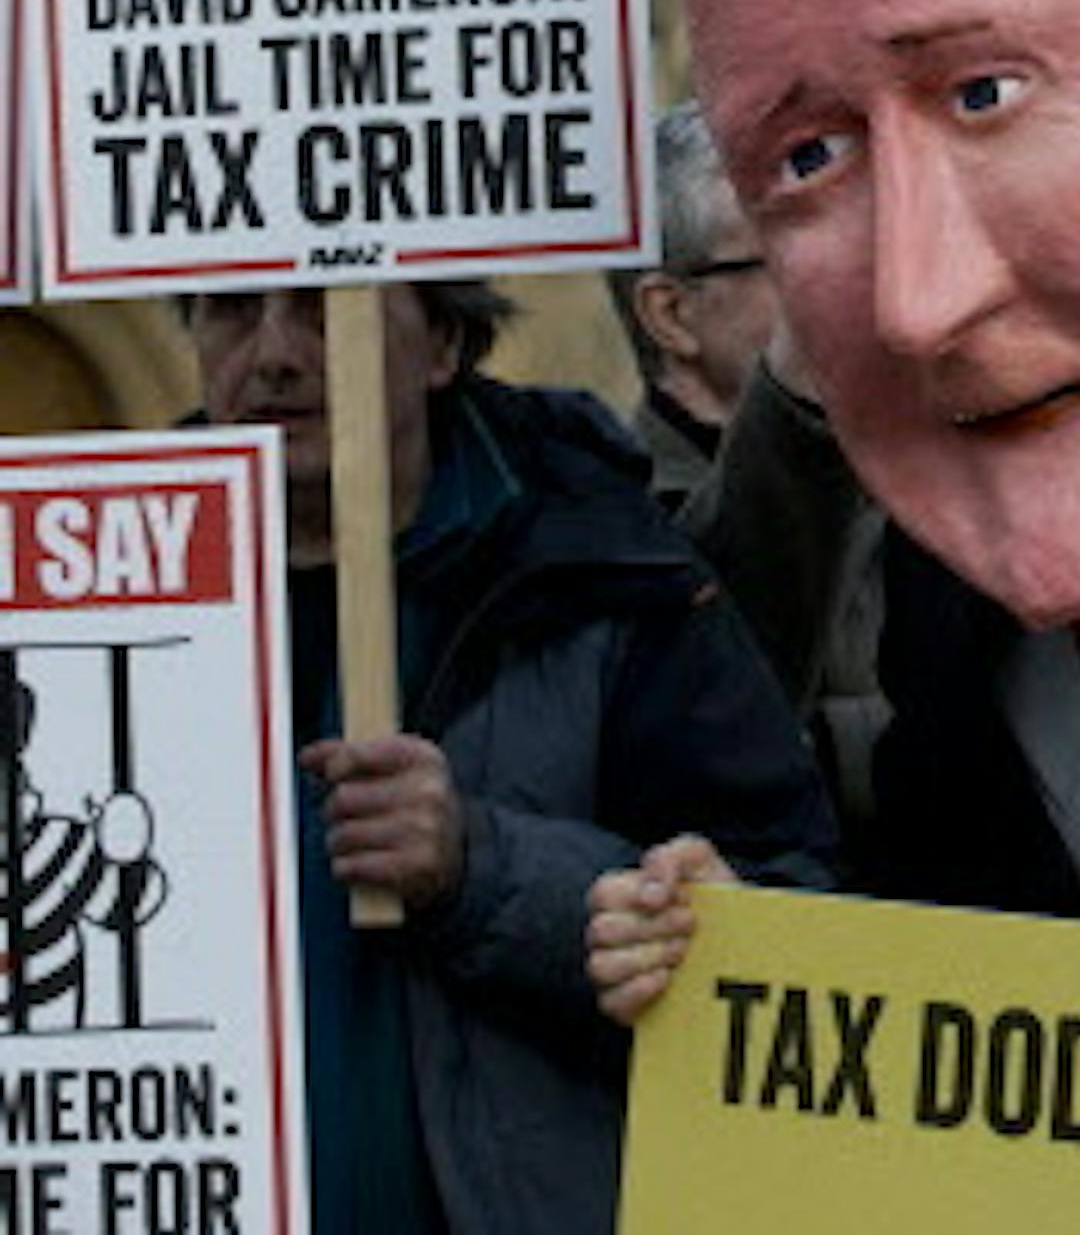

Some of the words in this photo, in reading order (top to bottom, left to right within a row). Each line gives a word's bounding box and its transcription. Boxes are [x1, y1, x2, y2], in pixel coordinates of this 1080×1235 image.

[91, 41, 239, 124] JAIL
[260, 26, 431, 113] TIME
[459, 20, 592, 98] FOR
[94, 129, 265, 237] TAX
[297, 110, 595, 225] CRIME
[35, 493, 197, 599] SAY
[714, 977, 886, 1121] TAX
[0, 1062, 239, 1144] MERON:
[101, 1159, 240, 1235] FOR
